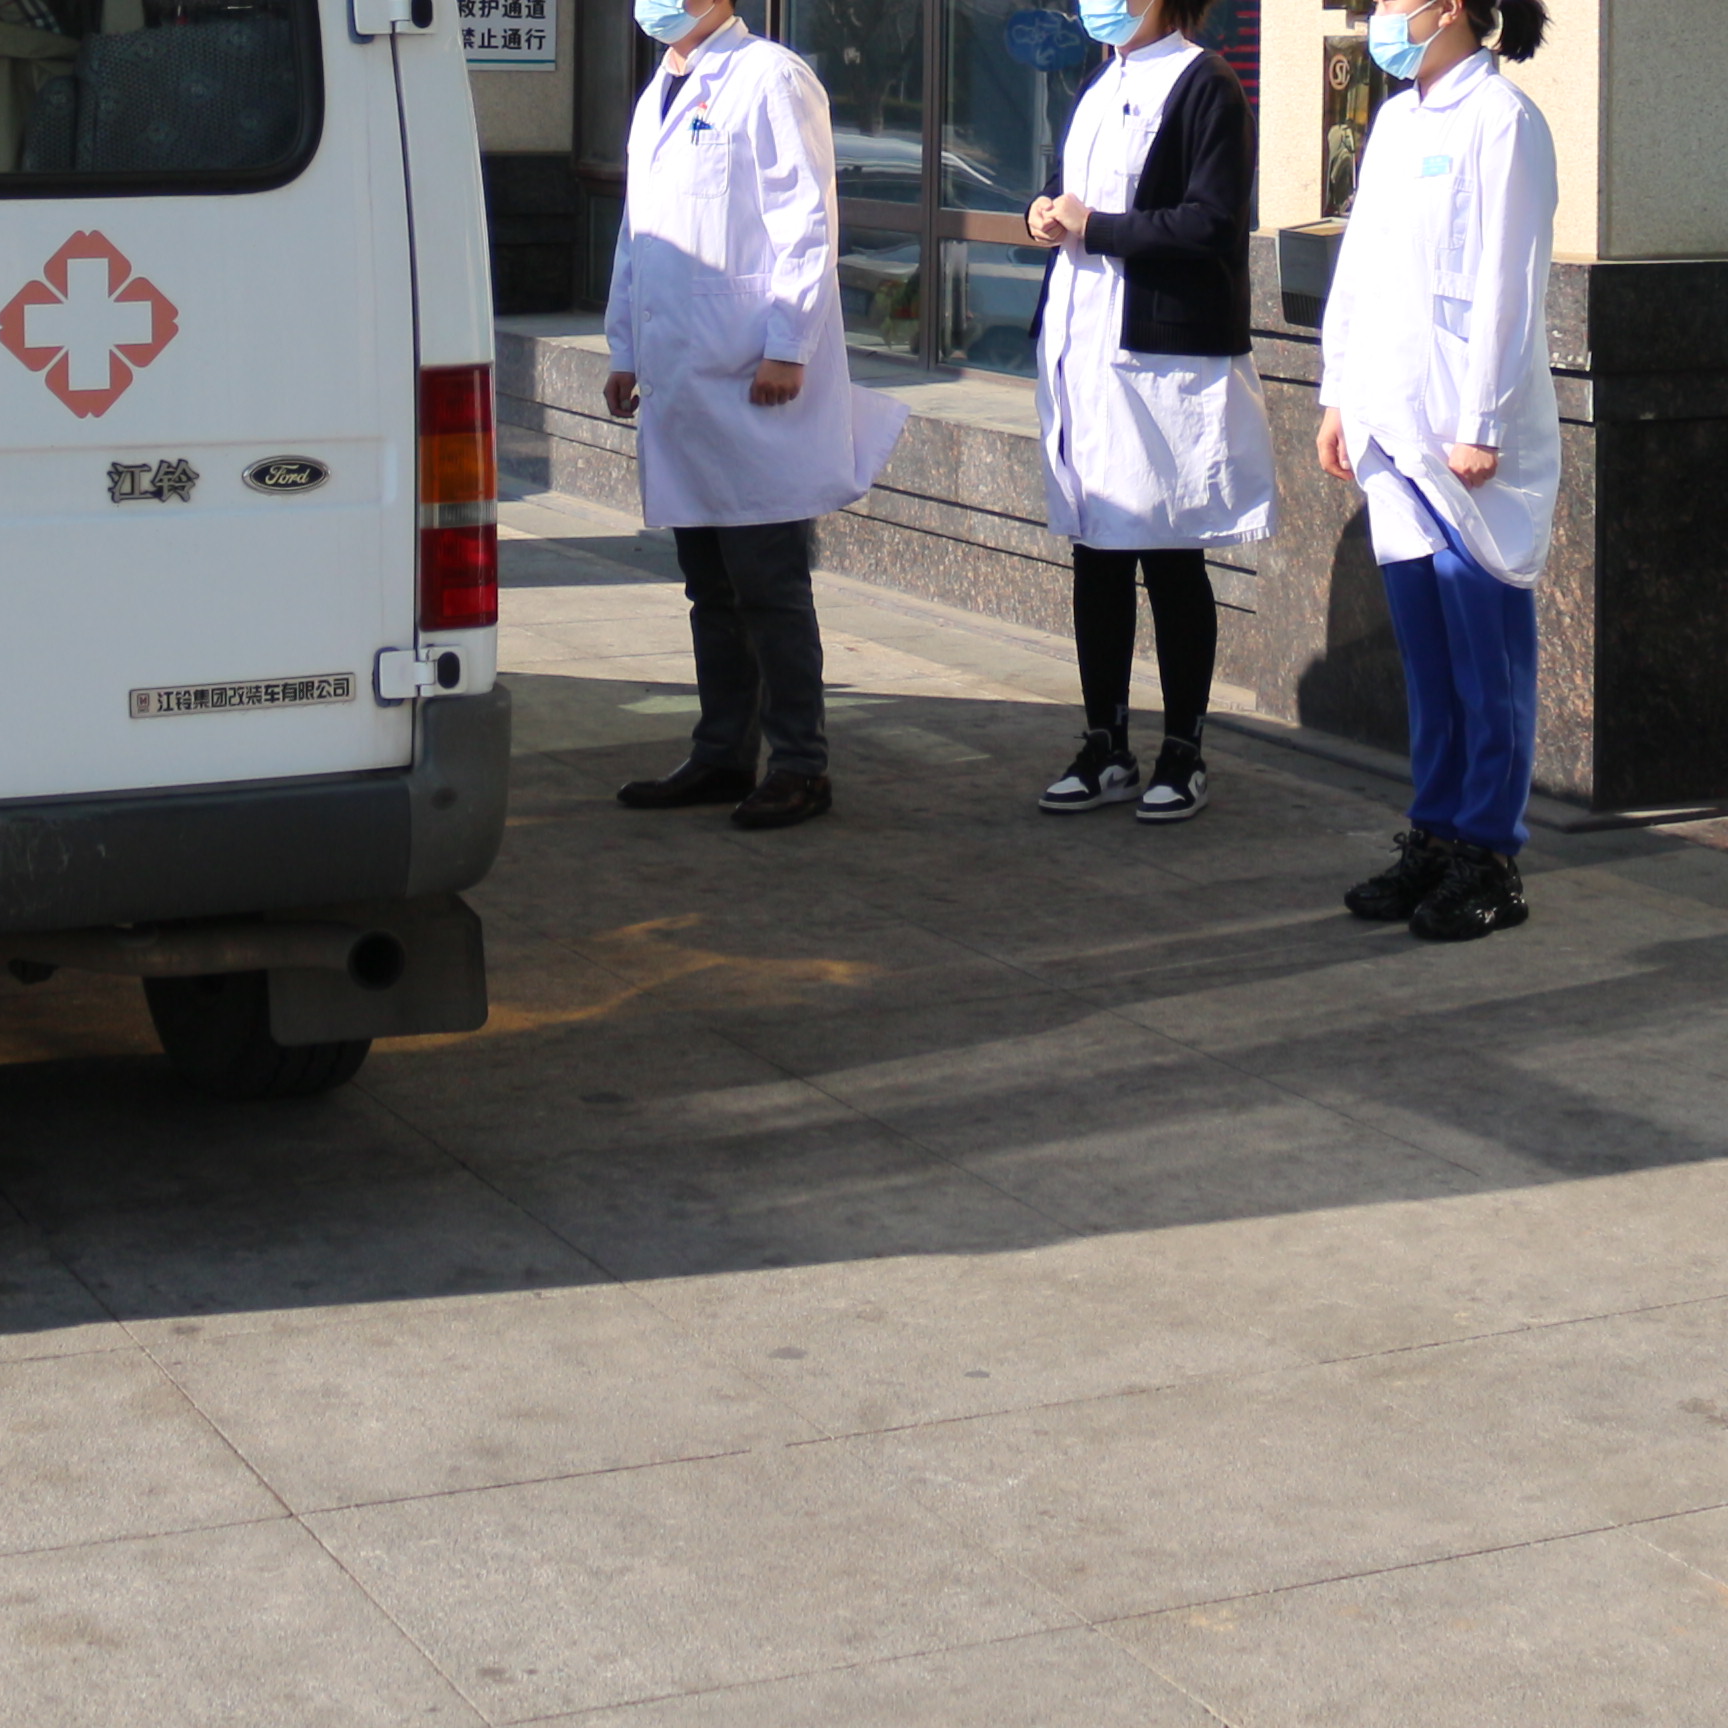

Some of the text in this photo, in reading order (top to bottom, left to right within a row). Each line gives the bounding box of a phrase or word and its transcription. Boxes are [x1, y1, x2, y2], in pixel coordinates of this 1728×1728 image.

[461, 27, 546, 50] 禁止通行
[107, 458, 200, 503] 江铃
[265, 463, 310, 485] Ford
[157, 677, 350, 712] 江铃集团改装车有限公司
